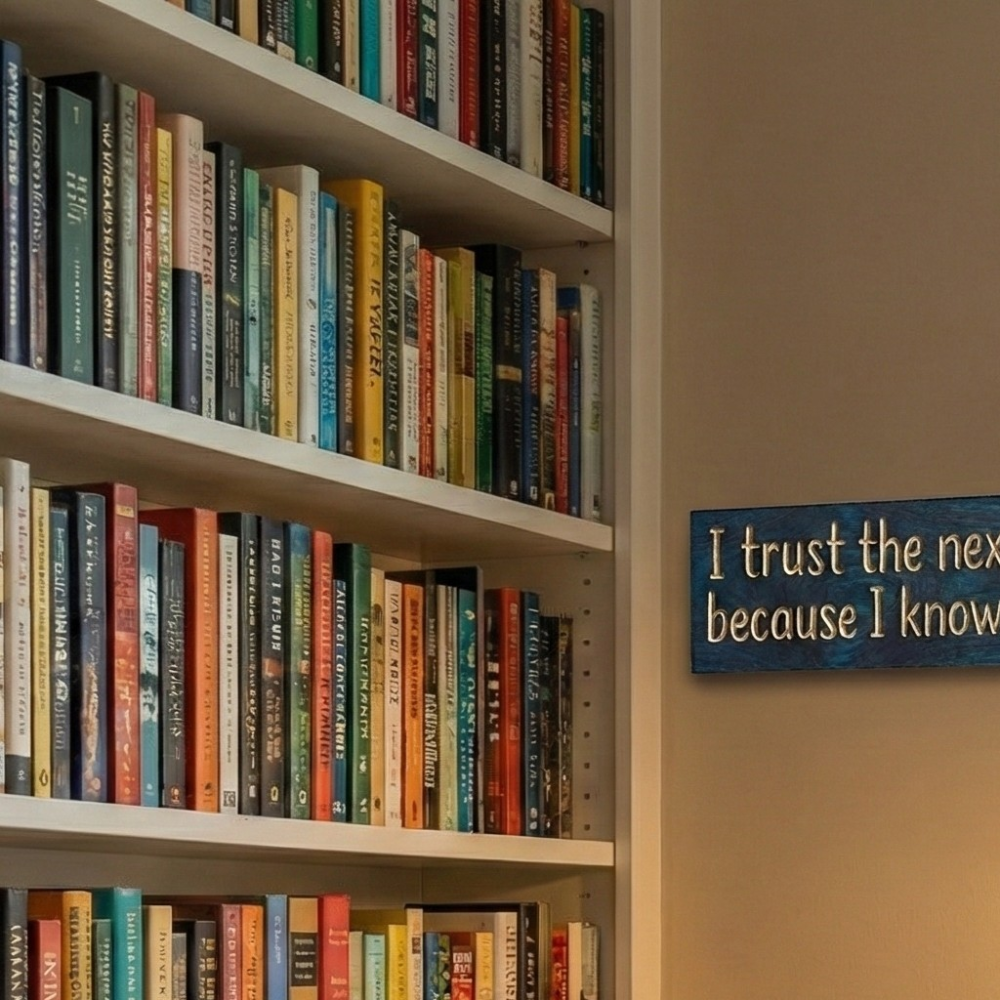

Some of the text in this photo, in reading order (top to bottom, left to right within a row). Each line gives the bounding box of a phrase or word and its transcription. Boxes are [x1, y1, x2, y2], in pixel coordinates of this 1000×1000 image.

[709, 527, 725, 580] I
[741, 522, 846, 578] trust
[858, 517, 922, 574] the
[707, 591, 857, 643] because
[869, 586, 885, 638] I
